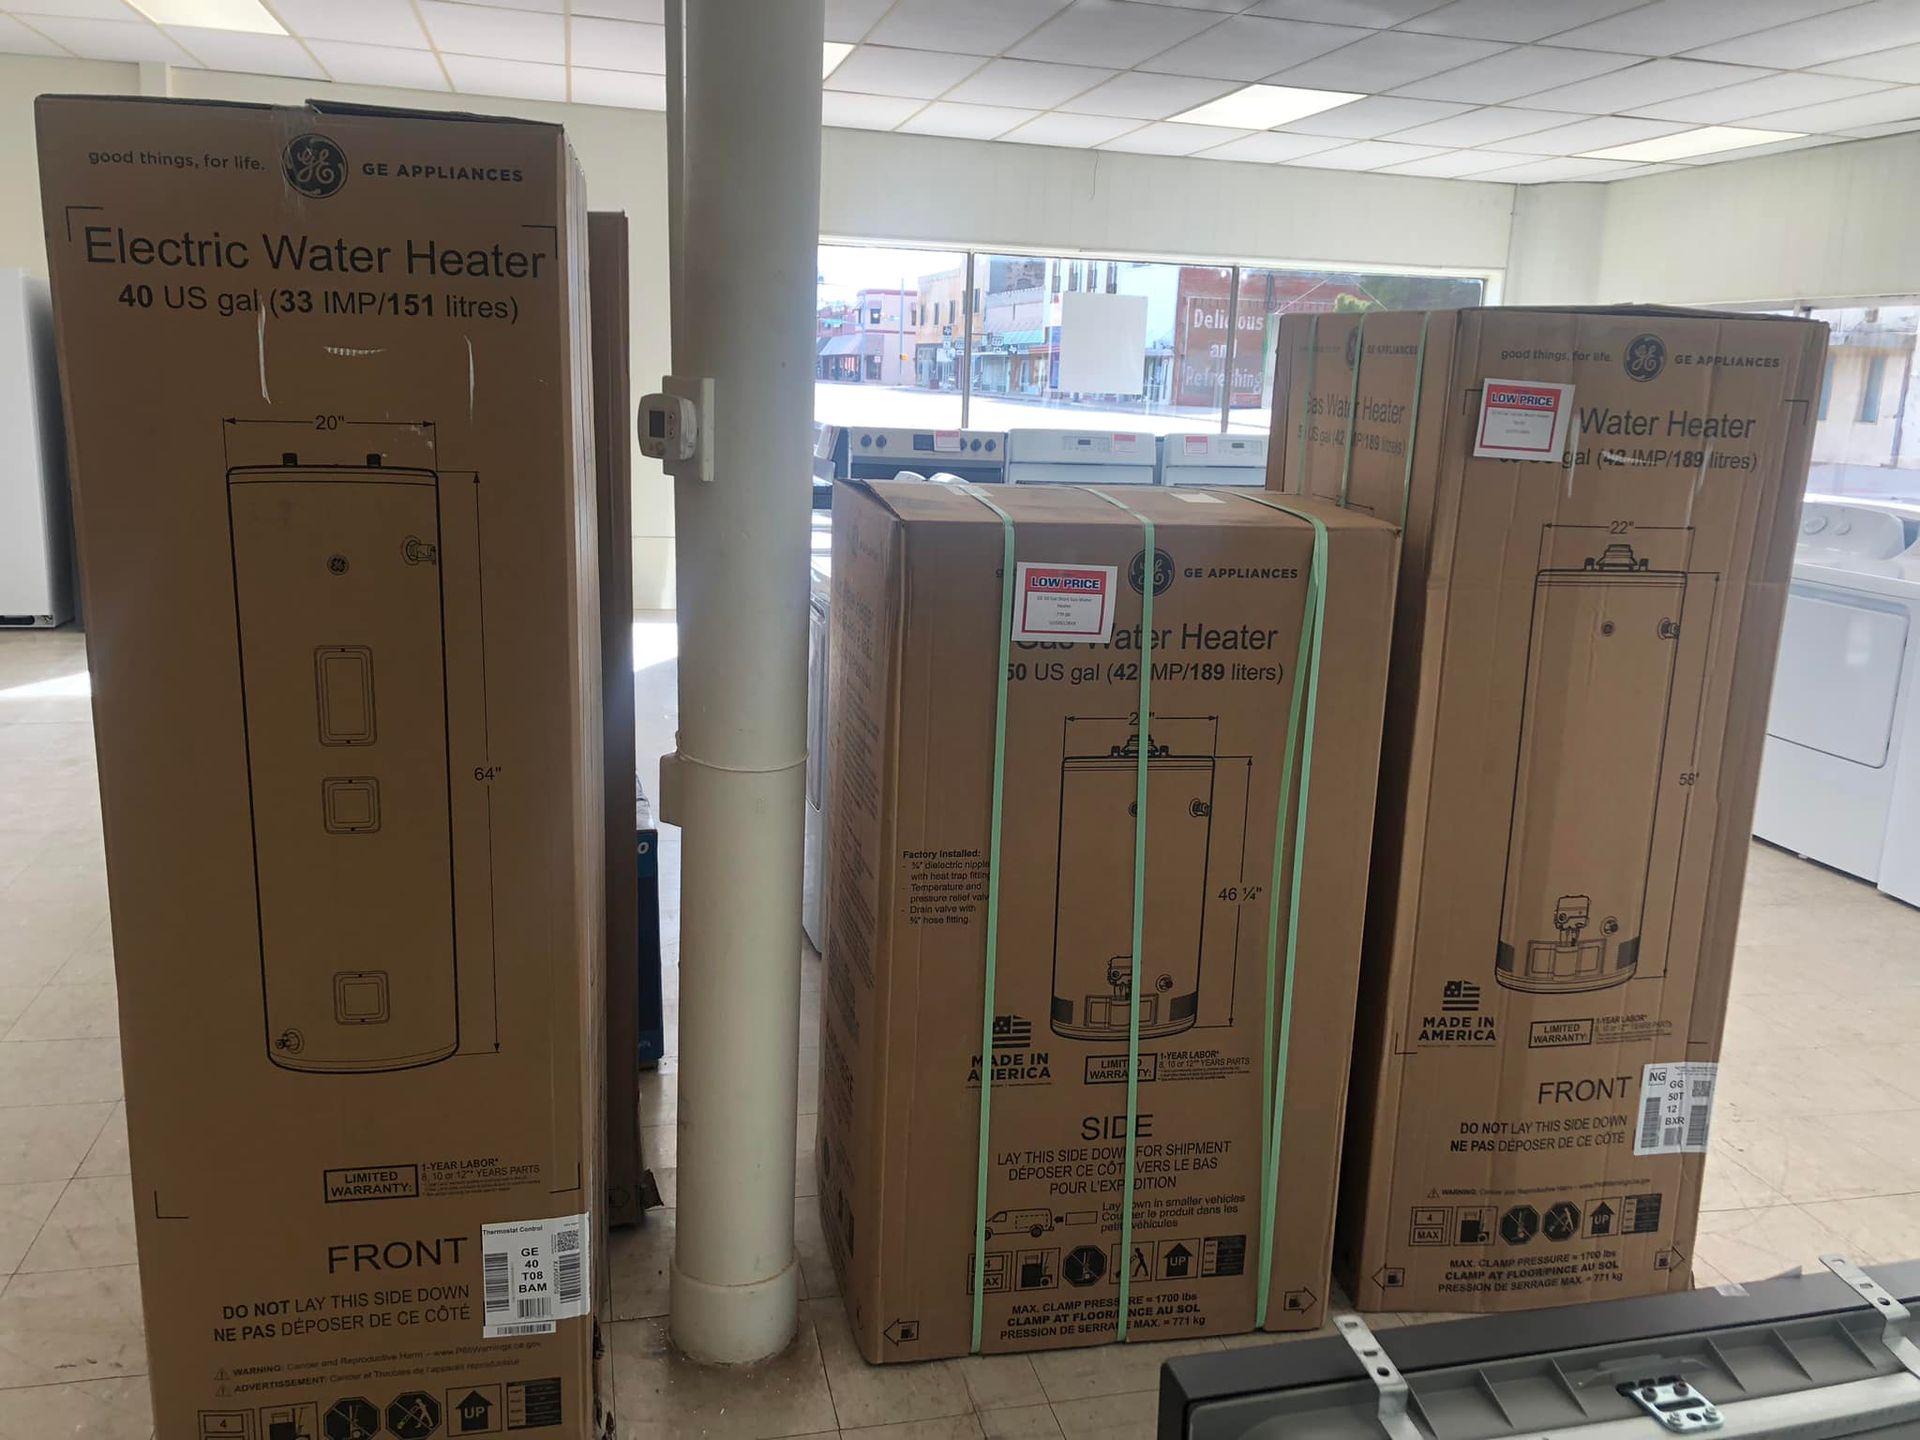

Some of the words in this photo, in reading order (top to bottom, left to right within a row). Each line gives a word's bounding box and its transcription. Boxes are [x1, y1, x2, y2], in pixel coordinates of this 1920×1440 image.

[88, 151, 134, 166] good
[140, 152, 200, 169] things,
[204, 154, 229, 168] for
[234, 156, 266, 171] life.
[362, 162, 388, 176] GE
[397, 164, 523, 182] APPLIANCES
[84, 226, 250, 269] Electric
[262, 233, 392, 274] Water
[407, 240, 546, 278] Heater
[119, 284, 153, 308] 40
[164, 285, 208, 310] US
[218, 288, 259, 316] gal
[270, 288, 314, 318] (33
[324, 291, 434, 317] IMP/151
[446, 294, 518, 325] litres)
[1194, 309, 1264, 331] Delicous
[1501, 350, 1530, 360] good
[1572, 351, 1590, 361] for
[1674, 354, 1696, 365] GE
[1697, 354, 1780, 368] APPLIANCES
[1186, 366, 1263, 394] Refrehing
[1492, 392, 1517, 404] LOW
[1519, 394, 1553, 407] PRICE
[315, 415, 345, 432] 20"
[1580, 407, 1660, 436] Water
[1666, 410, 1756, 439] Heater
[1562, 448, 1590, 468] gal
[1632, 450, 1704, 468] IMP/189
[1710, 452, 1758, 472] litres)
[1610, 520, 1635, 535] 22"
[1184, 568, 1202, 578] GE
[1208, 568, 1298, 579] APPLIANCES
[1032, 576, 1060, 588] LOW
[1063, 578, 1100, 589] PRICE
[1181, 624, 1278, 650] Heater
[1034, 663, 1064, 680] US
[1071, 664, 1100, 685] gal
[1106, 664, 1138, 685] (42
[1150, 664, 1224, 681] MP/189
[1231, 663, 1284, 685] liters)
[1128, 712, 1155, 726] 2"
[474, 766, 502, 782] 64"
[903, 850, 938, 860] Factory
[940, 849, 982, 858] Installed:
[912, 884, 964, 892] Temperature
[966, 882, 982, 890] and
[1218, 888, 1238, 901] 46
[910, 906, 932, 914] Drain
[1422, 1016, 1474, 1028] MADE
[1478, 1016, 1494, 1027] IN
[1544, 1023, 1580, 1034] LIMITED
[1418, 1030, 1496, 1042] AMERICA
[1031, 1052, 1049, 1064] IN
[1160, 1050, 1188, 1060] 1-YEAR
[1201, 1058, 1224, 1066] YEARS
[1226, 1056, 1250, 1066] PARTS
[1101, 1059, 1142, 1069] LIMITD
[1090, 1068, 1152, 1080] WARRATY:
[1650, 1072, 1666, 1082] NG
[1538, 1076, 1633, 1104] FRONT
[1670, 1080, 1684, 1088] GG
[1667, 1104, 1678, 1113] 12
[1081, 1114, 1153, 1140] SIDE
[1460, 1122, 1478, 1134] DO
[1482, 1122, 1508, 1134] NOT
[1510, 1121, 1532, 1134] LAY
[1536, 1120, 1560, 1133] THIS
[1564, 1118, 1590, 1131] SIDE
[1592, 1115, 1628, 1129] DOWN
[1664, 1116, 1685, 1126] BXR
[1450, 1140, 1470, 1152] NE
[1471, 1139, 1495, 1152] PAS
[1498, 1135, 1555, 1152] DÉPOSER
[1558, 1136, 1574, 1148] DE
[1576, 1134, 1594, 1147] CE
[998, 1152, 1022, 1166] LAY
[1026, 1150, 1055, 1164] THIS
[1058, 1148, 1088, 1162] SIDE
[1136, 1144, 1162, 1158] FOR
[1165, 1140, 1232, 1156] SHIPMENT
[422, 1160, 456, 1172] 1-YEAR
[433, 1171, 443, 1180] 10
[445, 1172, 454, 1180] or
[476, 1166, 508, 1177] YEARS
[510, 1164, 540, 1175] PARTS
[1008, 1161, 1072, 1182] DÉPOSER
[1076, 1164, 1094, 1177] CE
[1097, 1160, 1126, 1176] CÔT
[1136, 1160, 1171, 1173] VERS
[1174, 1158, 1189, 1172] LE
[1192, 1156, 1218, 1170] BAS
[344, 1170, 399, 1184] LIMITED
[331, 1182, 412, 1198] WARRANTY:
[1050, 1182, 1087, 1196] POUR
[1090, 1176, 1177, 1193] L'EXPDITION
[1102, 1202, 1121, 1212] Lay
[1154, 1198, 1164, 1208] in
[1166, 1196, 1202, 1206] smaller
[1204, 1194, 1246, 1205] vehicles
[1159, 1206, 1198, 1219] produit
[1224, 1204, 1238, 1214] les
[1593, 1214, 1609, 1225] UP
[483, 1226, 518, 1236] Thermostat
[520, 1225, 543, 1233] Control
[1417, 1230, 1439, 1240] MAX
[328, 1236, 468, 1274] FRONT
[520, 1247, 540, 1257] GE
[1478, 1257, 1515, 1268] CLAMP
[1518, 1254, 1570, 1266] PRESSURE
[1580, 1250, 1601, 1260] 1700
[524, 1260, 539, 1268] 40
[1170, 1256, 1186, 1266] UP
[522, 1271, 544, 1281] T08
[1446, 1271, 1486, 1281] CLAMP
[1488, 1270, 1504, 1280] AT
[1580, 1264, 1595, 1272] AU
[1598, 1261, 1619, 1270] SOL
[518, 1282, 547, 1294] BAM
[1438, 1282, 1492, 1293] PRESSION
[1494, 1282, 1508, 1291] DE
[1510, 1278, 1558, 1290] SERRAGE
[1594, 1273, 1608, 1282] 771
[1611, 1272, 1623, 1282] kg
[222, 1304, 248, 1320] DO
[254, 1300, 291, 1318] NOT
[295, 1296, 326, 1313] LAY
[331, 1292, 369, 1309] THIS
[374, 1288, 412, 1306] SIDE
[418, 1284, 470, 1302] DOWN
[1012, 1304, 1038, 1314] MAX.
[1042, 1300, 1082, 1312] CLAMP
[1084, 1296, 1144, 1308] PRESSRE
[1156, 1294, 1180, 1304] 1700
[1182, 1292, 1198, 1302] lbs
[213, 1328, 236, 1342] NE
[242, 1324, 276, 1340] PAS
[281, 1314, 364, 1336] DÉPOSER
[370, 1312, 392, 1328] DE
[397, 1310, 420, 1326] CE
[424, 1302, 471, 1323] CÔTÉ
[1008, 1314, 1050, 1327] CLAMP
[1053, 1312, 1070, 1323] AT
[1156, 1306, 1174, 1316] AU
[1176, 1304, 1200, 1314] SOL
[1000, 1326, 1057, 1340] PRESSION
[1060, 1324, 1074, 1334] DE
[1134, 1318, 1160, 1328] MAX.
[1172, 1316, 1190, 1326] 771
[1192, 1316, 1206, 1327] kg
[464, 1406, 486, 1419] UP
[220, 1418, 228, 1428] 4
